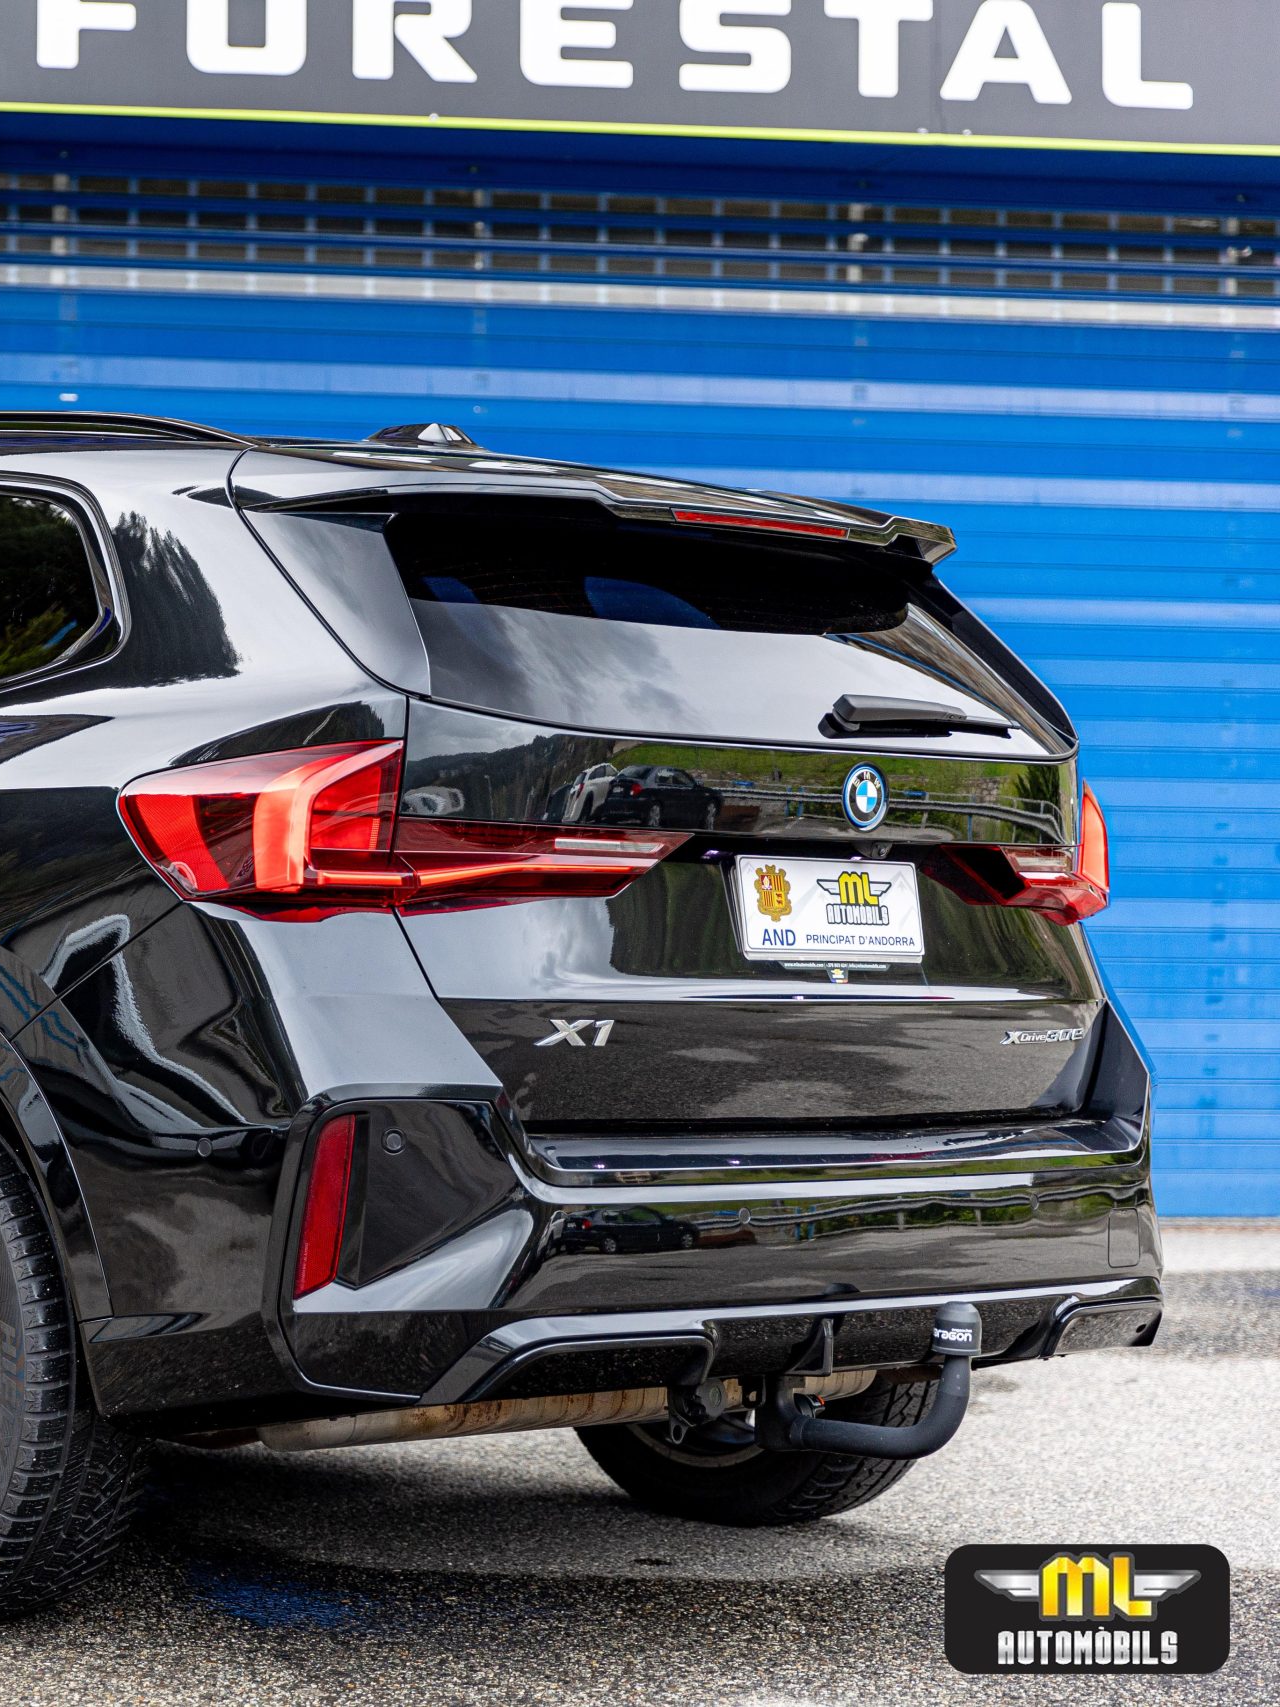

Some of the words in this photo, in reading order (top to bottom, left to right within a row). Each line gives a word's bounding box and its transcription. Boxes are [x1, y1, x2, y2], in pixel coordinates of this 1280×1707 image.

[36, 0, 1195, 110] FORESTAL
[838, 871, 879, 906] ML
[762, 929, 796, 946] AND
[806, 934, 855, 945] PRINCIPAT
[859, 936, 915, 947] D'ANDORRA
[533, 1019, 615, 1046] X1
